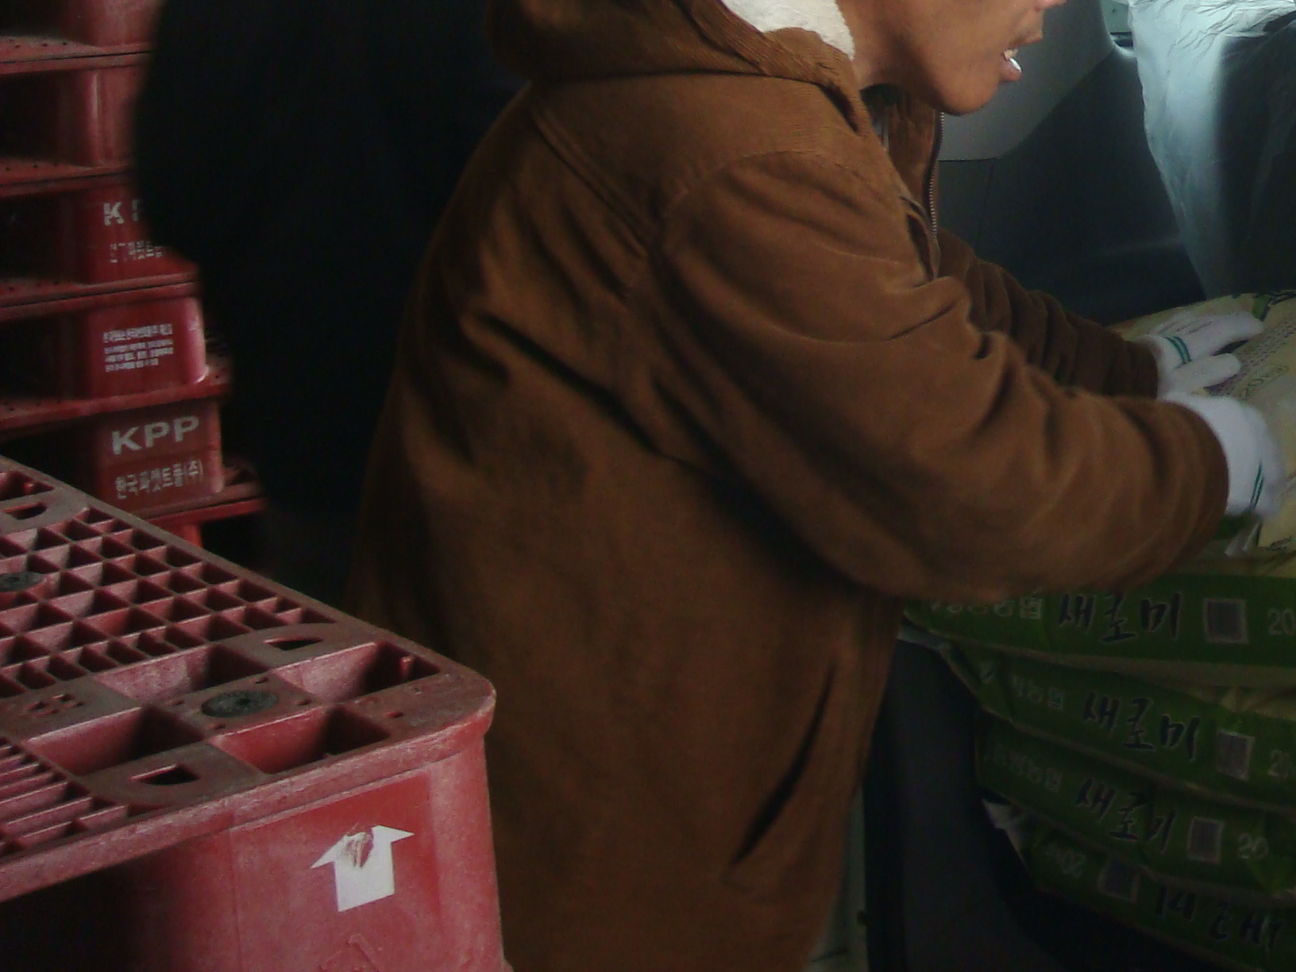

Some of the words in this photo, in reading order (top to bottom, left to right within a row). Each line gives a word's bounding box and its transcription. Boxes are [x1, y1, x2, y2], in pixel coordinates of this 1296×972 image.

[111, 415, 200, 455] KPP
[1058, 591, 1183, 642] 새로미
[1083, 691, 1200, 761] 새로미
